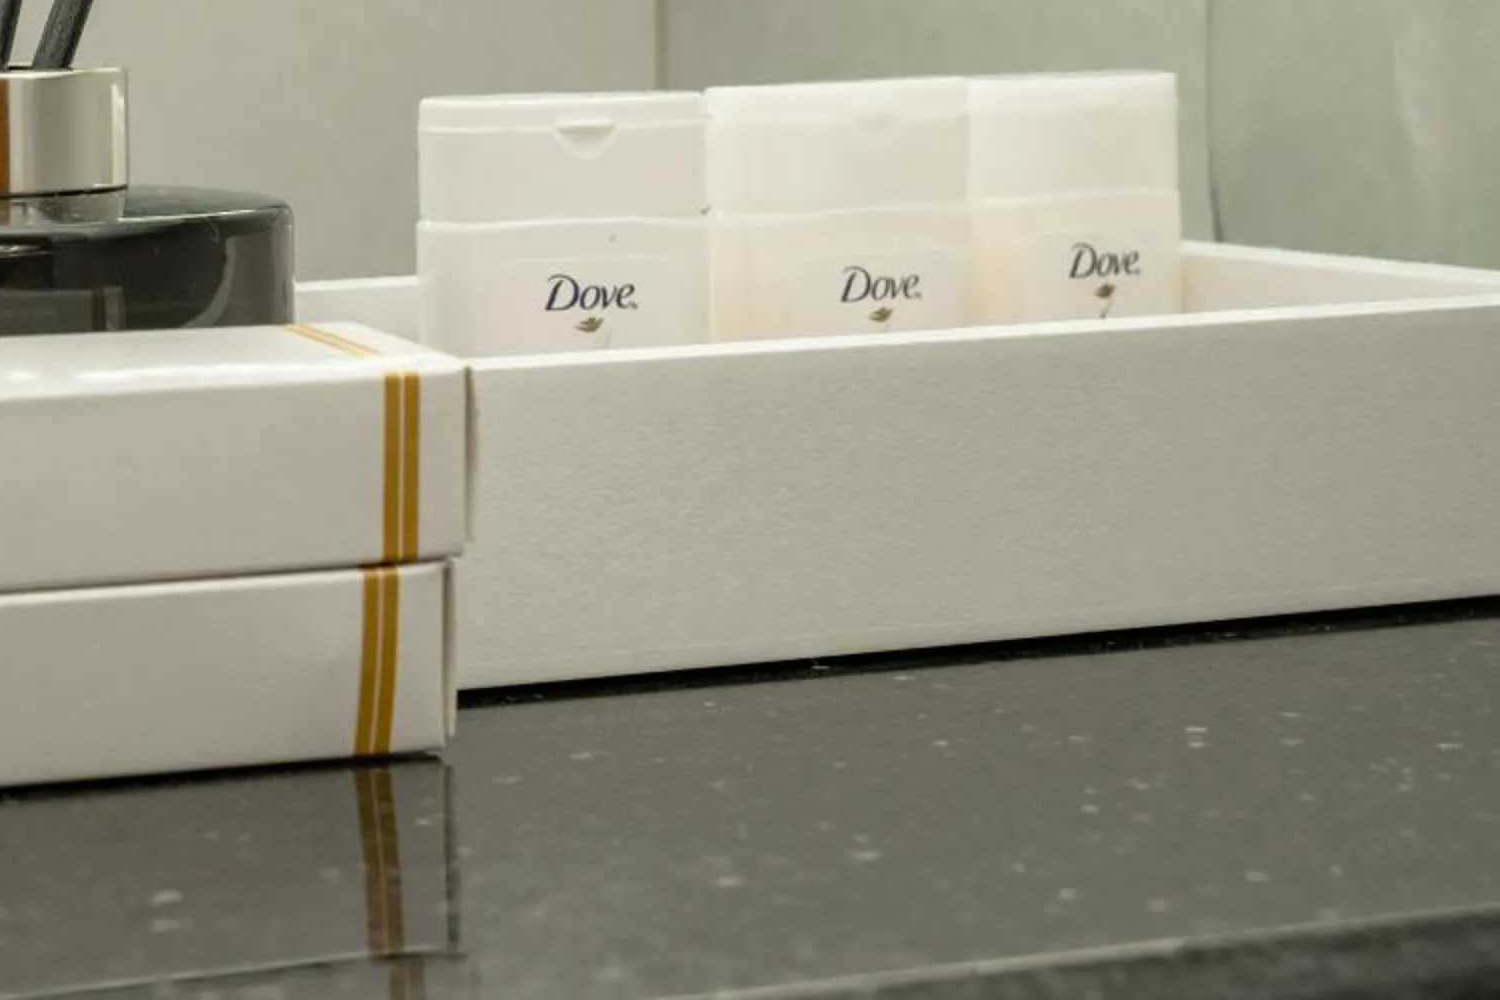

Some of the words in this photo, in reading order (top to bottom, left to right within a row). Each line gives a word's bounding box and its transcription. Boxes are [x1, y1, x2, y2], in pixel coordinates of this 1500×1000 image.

[1069, 241, 1141, 279] Dove
[544, 273, 638, 311] Dove
[840, 265, 922, 303] Dove
